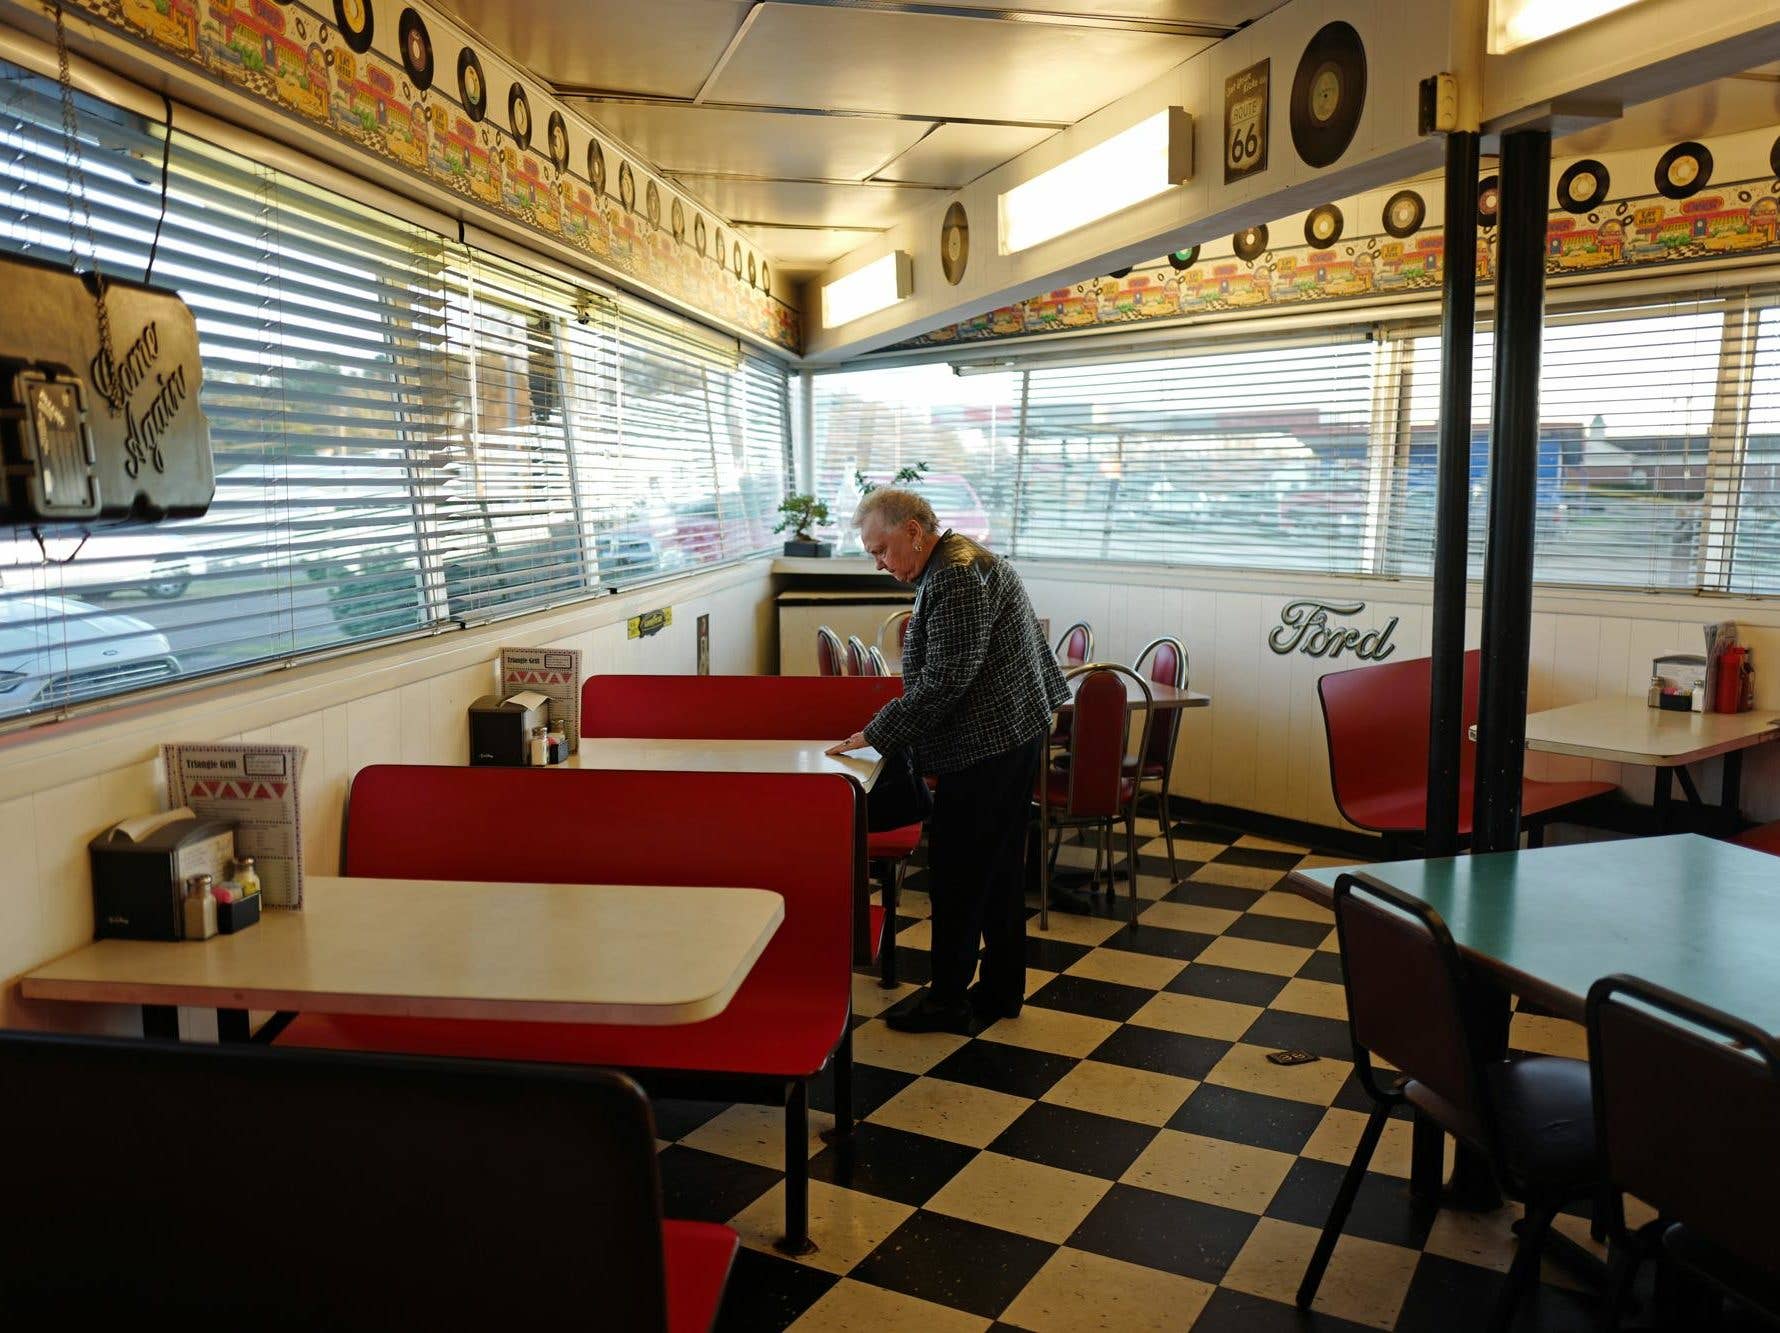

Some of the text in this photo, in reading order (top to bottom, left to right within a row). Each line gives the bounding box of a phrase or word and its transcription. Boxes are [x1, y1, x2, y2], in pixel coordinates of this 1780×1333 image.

[1232, 100, 1258, 121] ROUTE
[1231, 122, 1258, 163] 66
[124, 364, 187, 480] Again
[1268, 599, 1399, 661] Ford
[186, 759, 218, 769] Triangle
[219, 759, 237, 769] Grill
